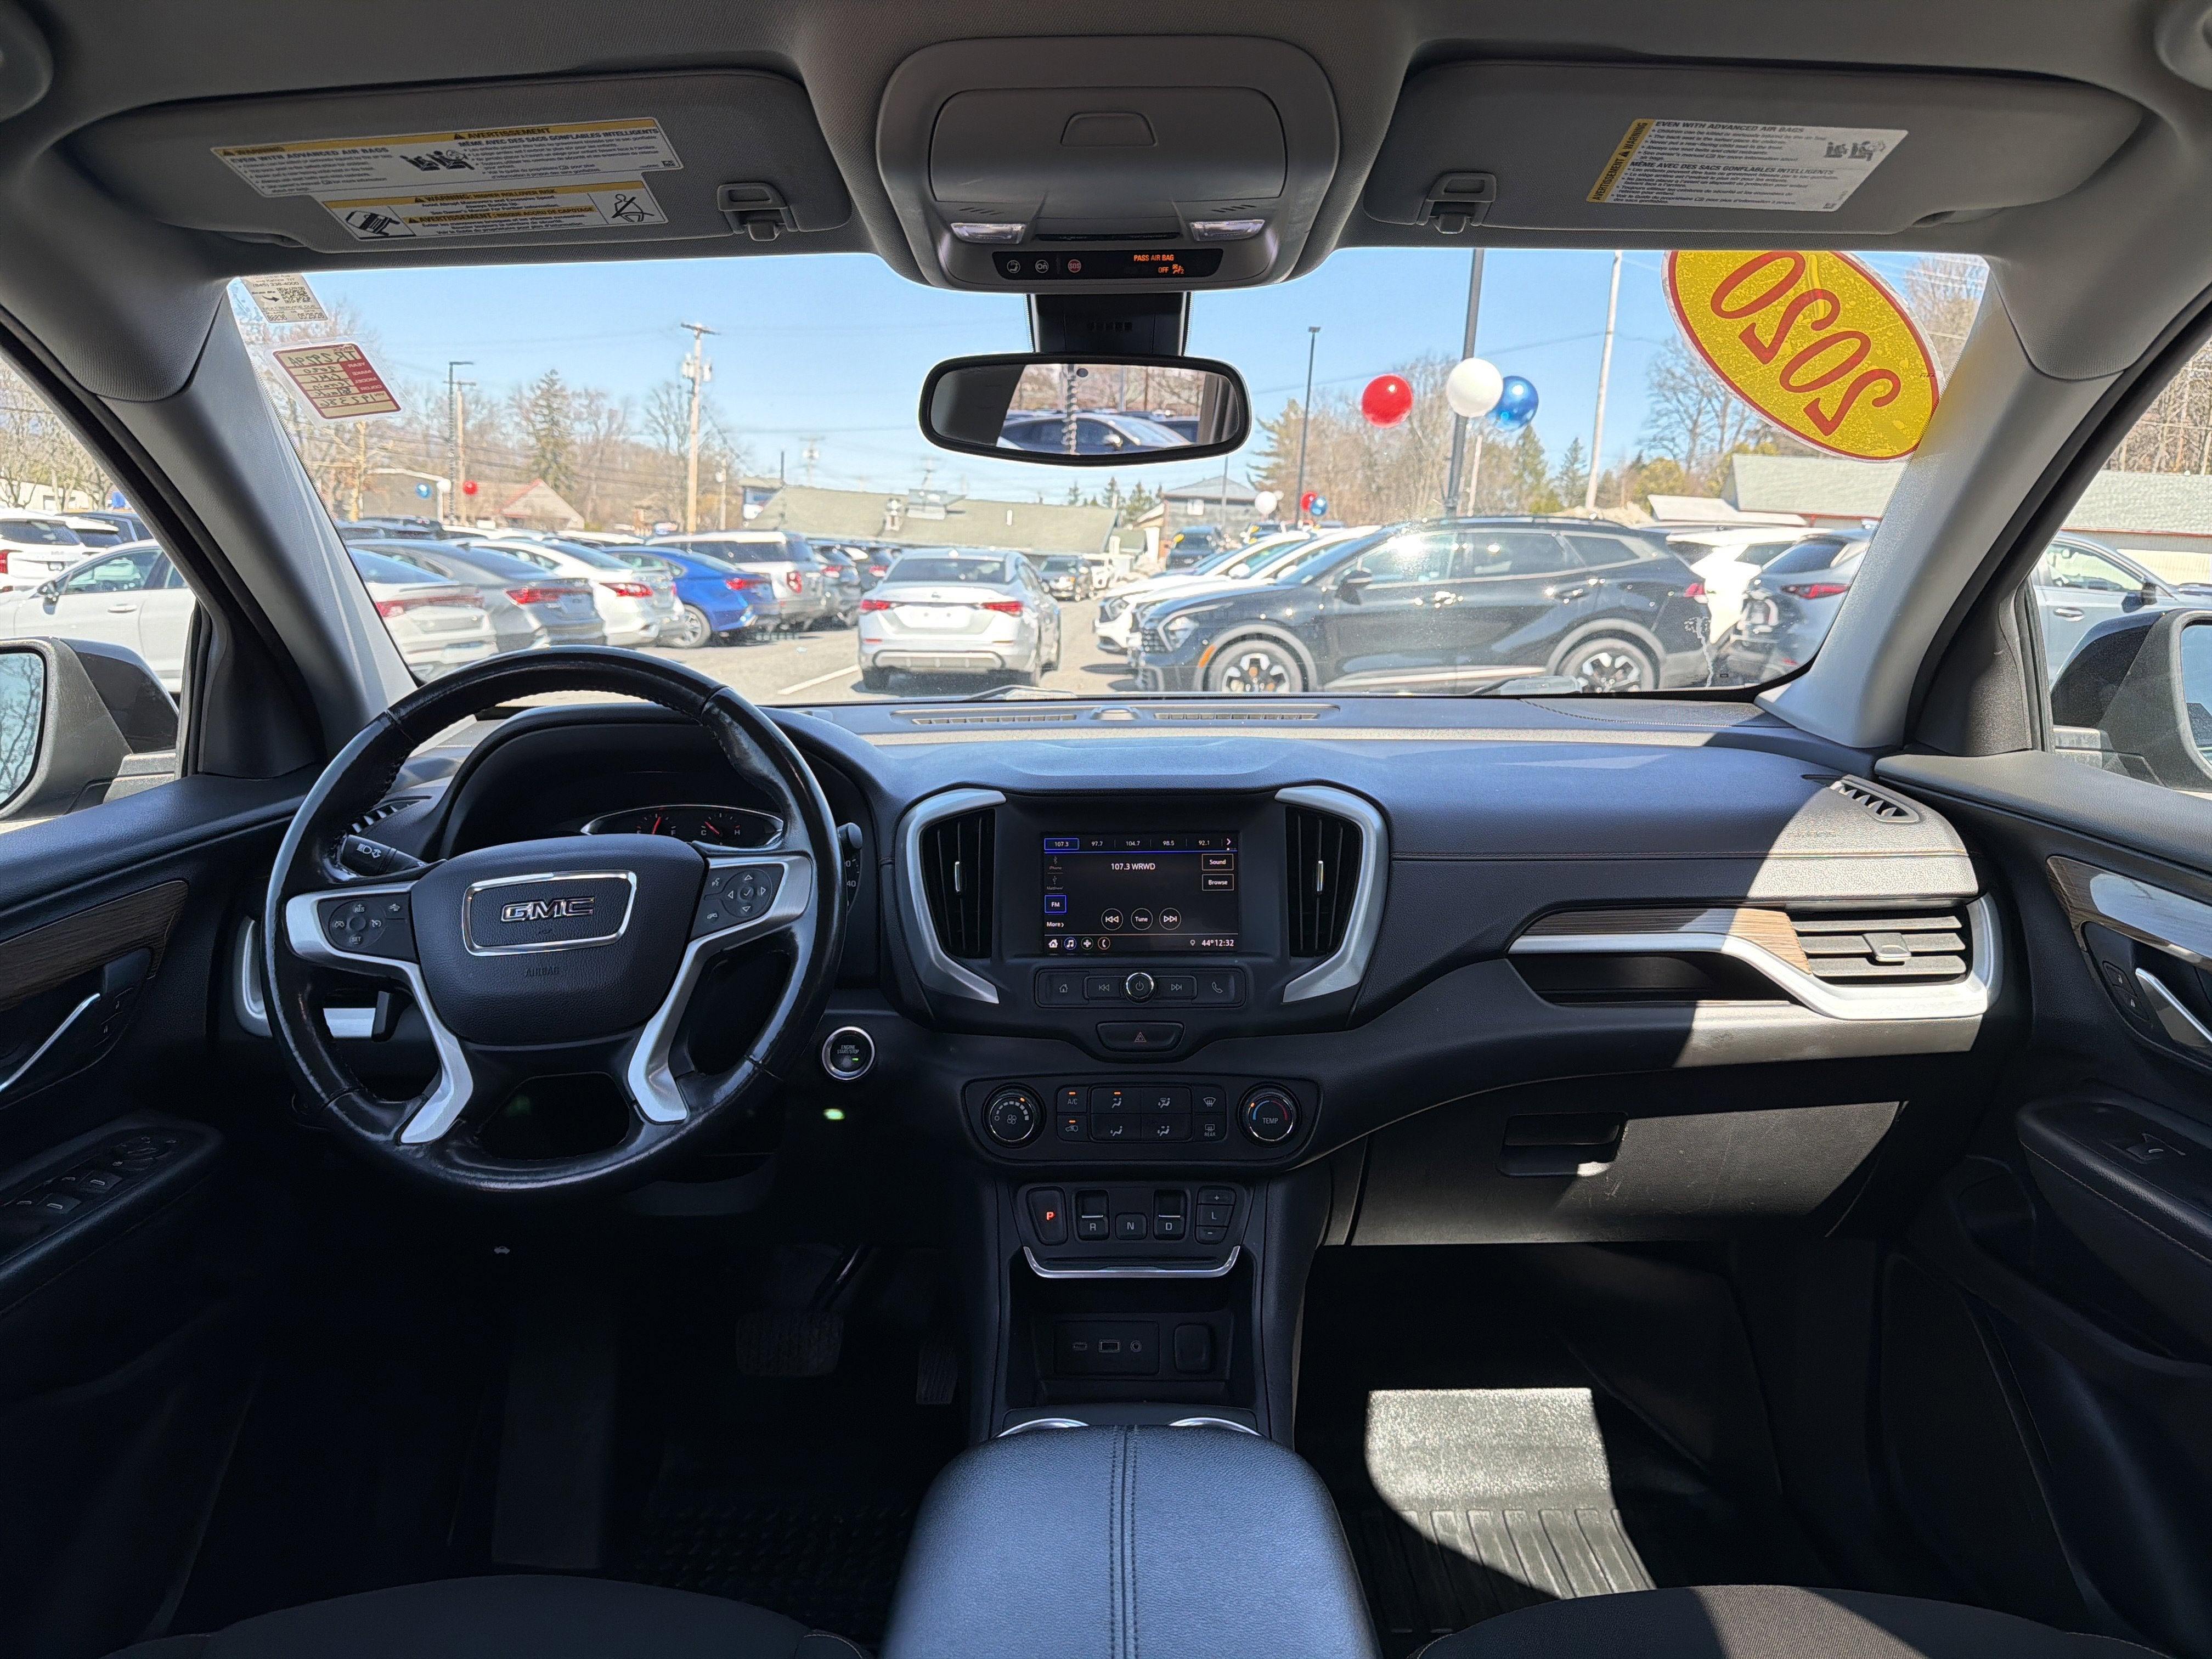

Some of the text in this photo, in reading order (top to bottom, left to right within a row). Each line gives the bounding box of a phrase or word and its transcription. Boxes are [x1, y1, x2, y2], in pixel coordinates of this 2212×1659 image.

[468, 127, 550, 139] AVERTISSEMENT
[549, 133, 601, 142] GONFLABLES
[602, 128, 659, 138] INTELLIGENTS
[1622, 122, 1648, 149] WARNING
[286, 150, 338, 159] ADVANCED
[1592, 158, 1625, 200] AVERTISSEMENT
[419, 213, 491, 223] AVERTISSEMENT
[500, 896, 595, 923] GMC
[1068, 1098, 1078, 1106] A/C
[1046, 1211, 1055, 1221] P
[1090, 1223, 1097, 1231] R
[1127, 1222, 1134, 1230] N
[1165, 1222, 1172, 1231] D
